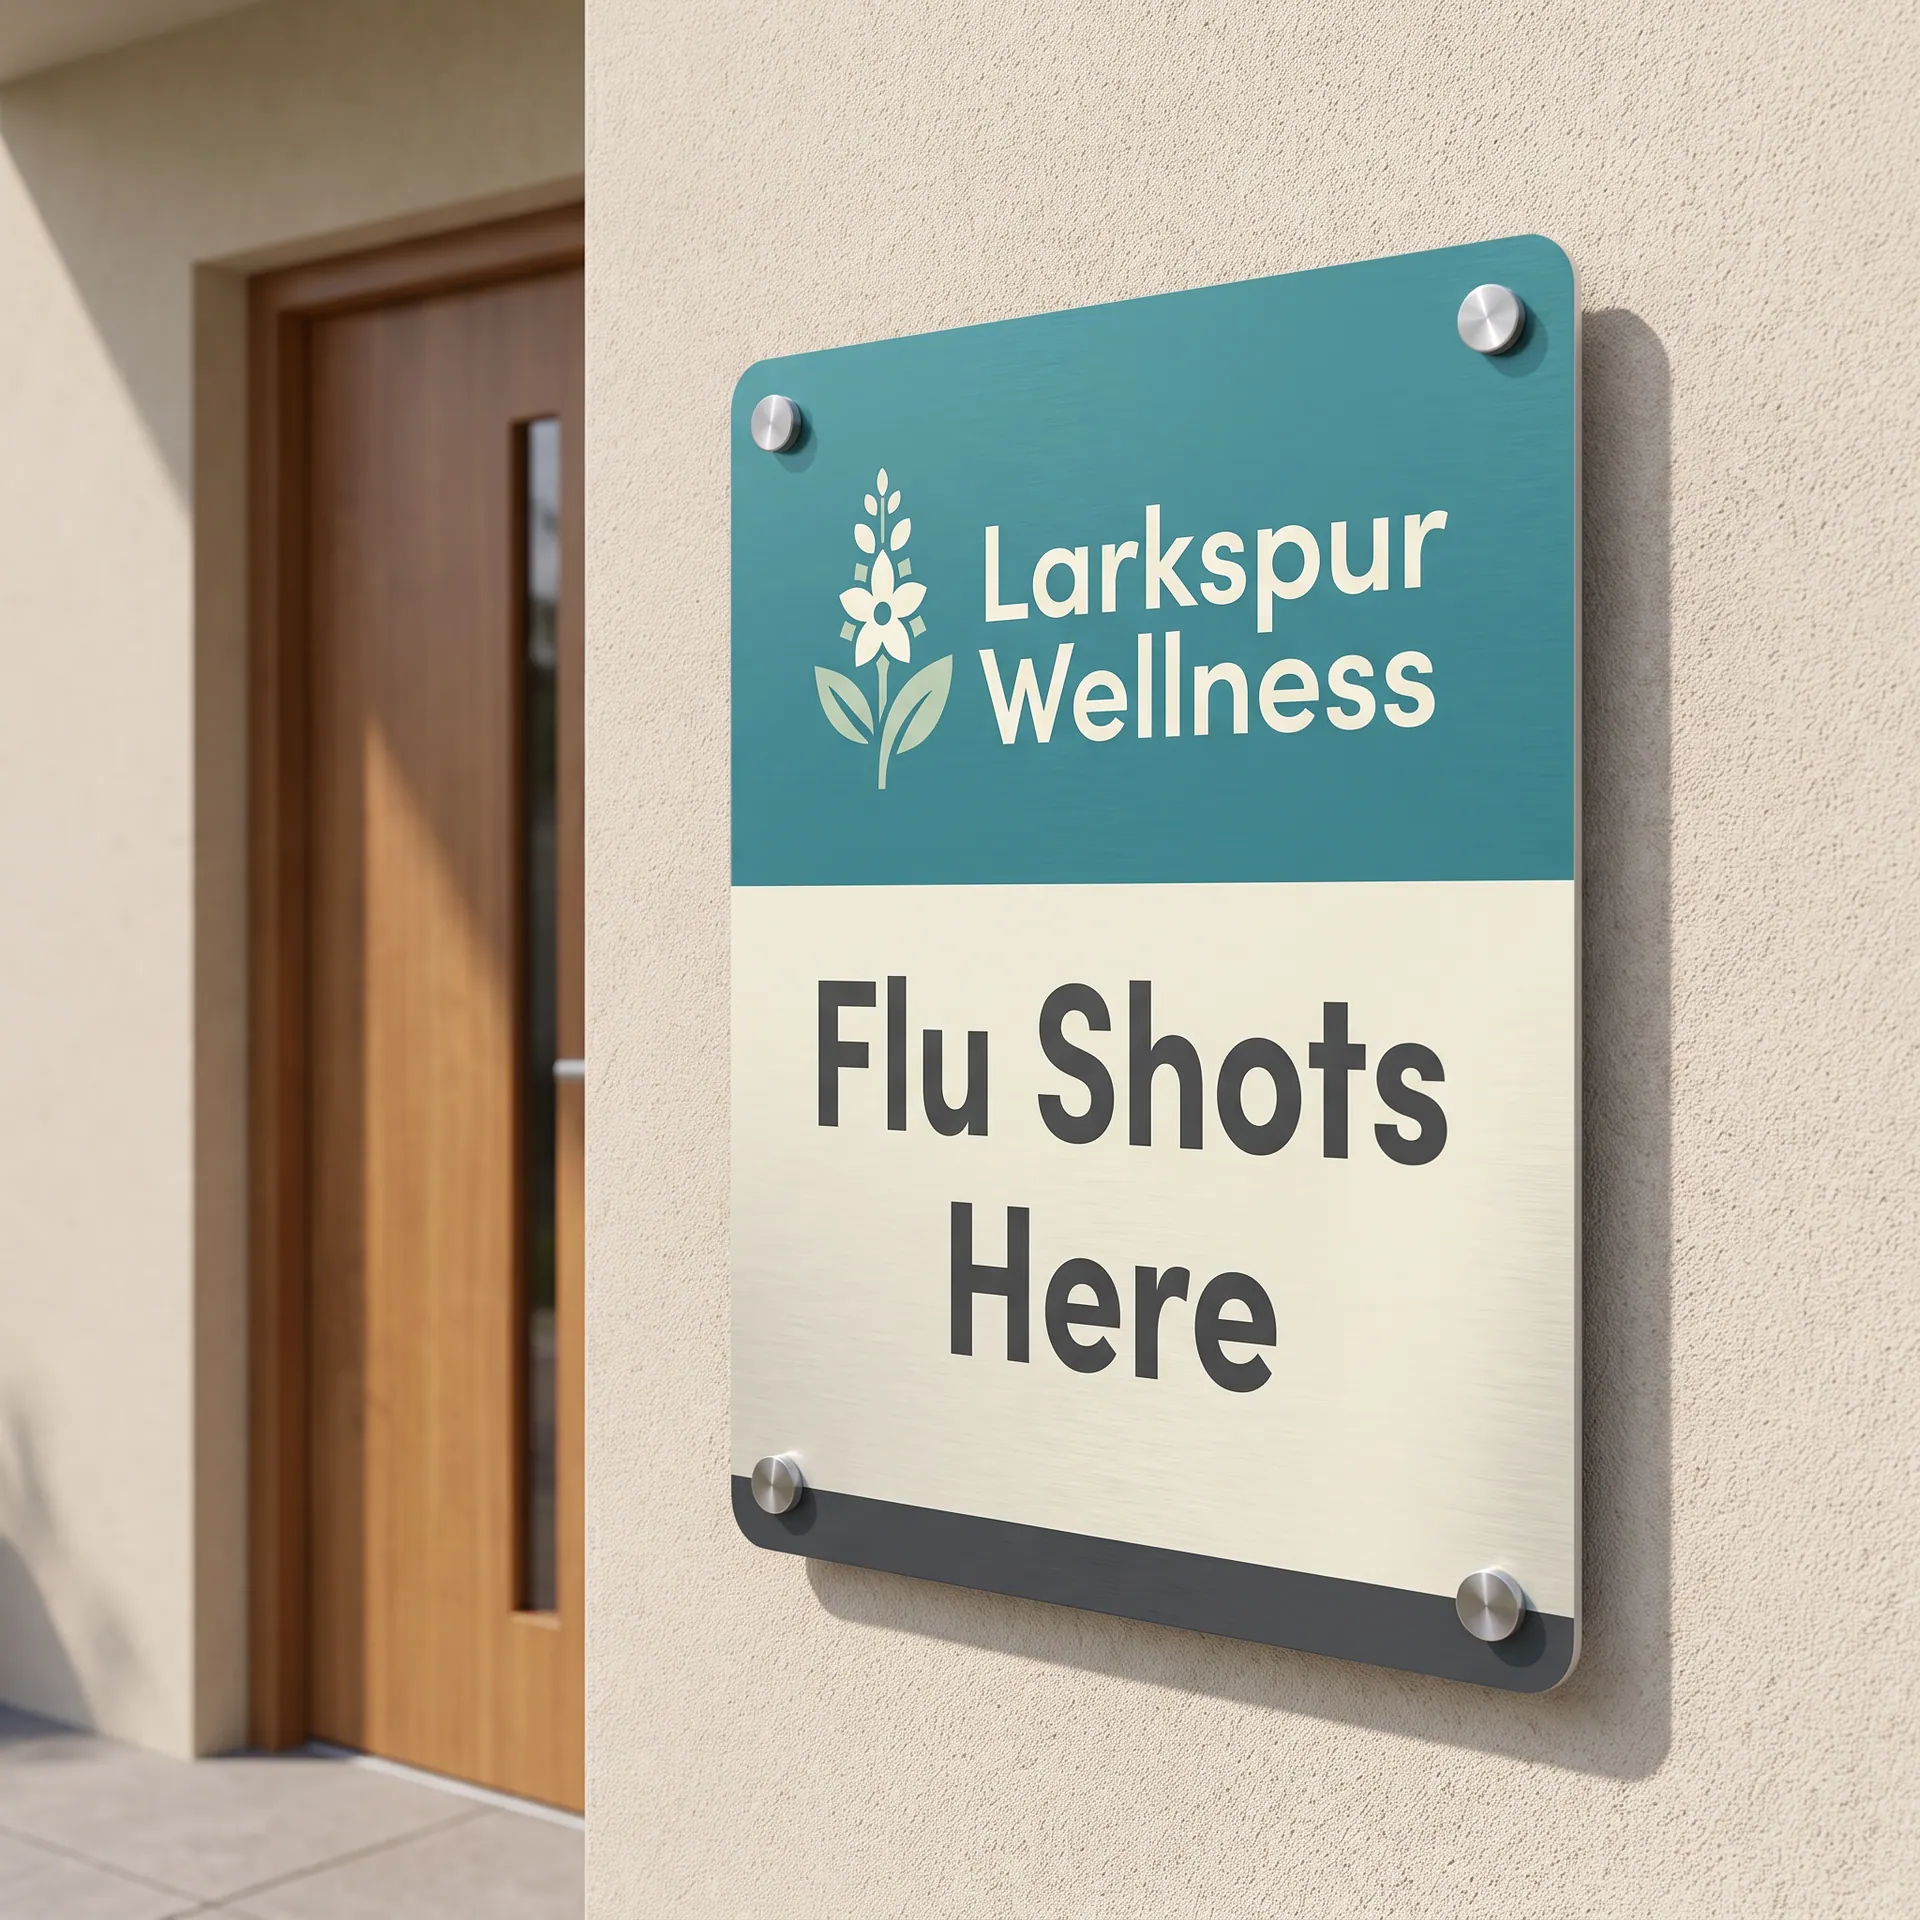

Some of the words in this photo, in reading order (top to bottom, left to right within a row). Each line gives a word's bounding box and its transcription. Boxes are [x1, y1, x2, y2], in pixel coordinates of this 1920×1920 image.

[985, 503, 1449, 634] Larkspur
[978, 630, 1436, 745] Wellness
[817, 975, 989, 1137] Flu
[1037, 979, 1448, 1166] Shots
[950, 1201, 1277, 1393] Here
